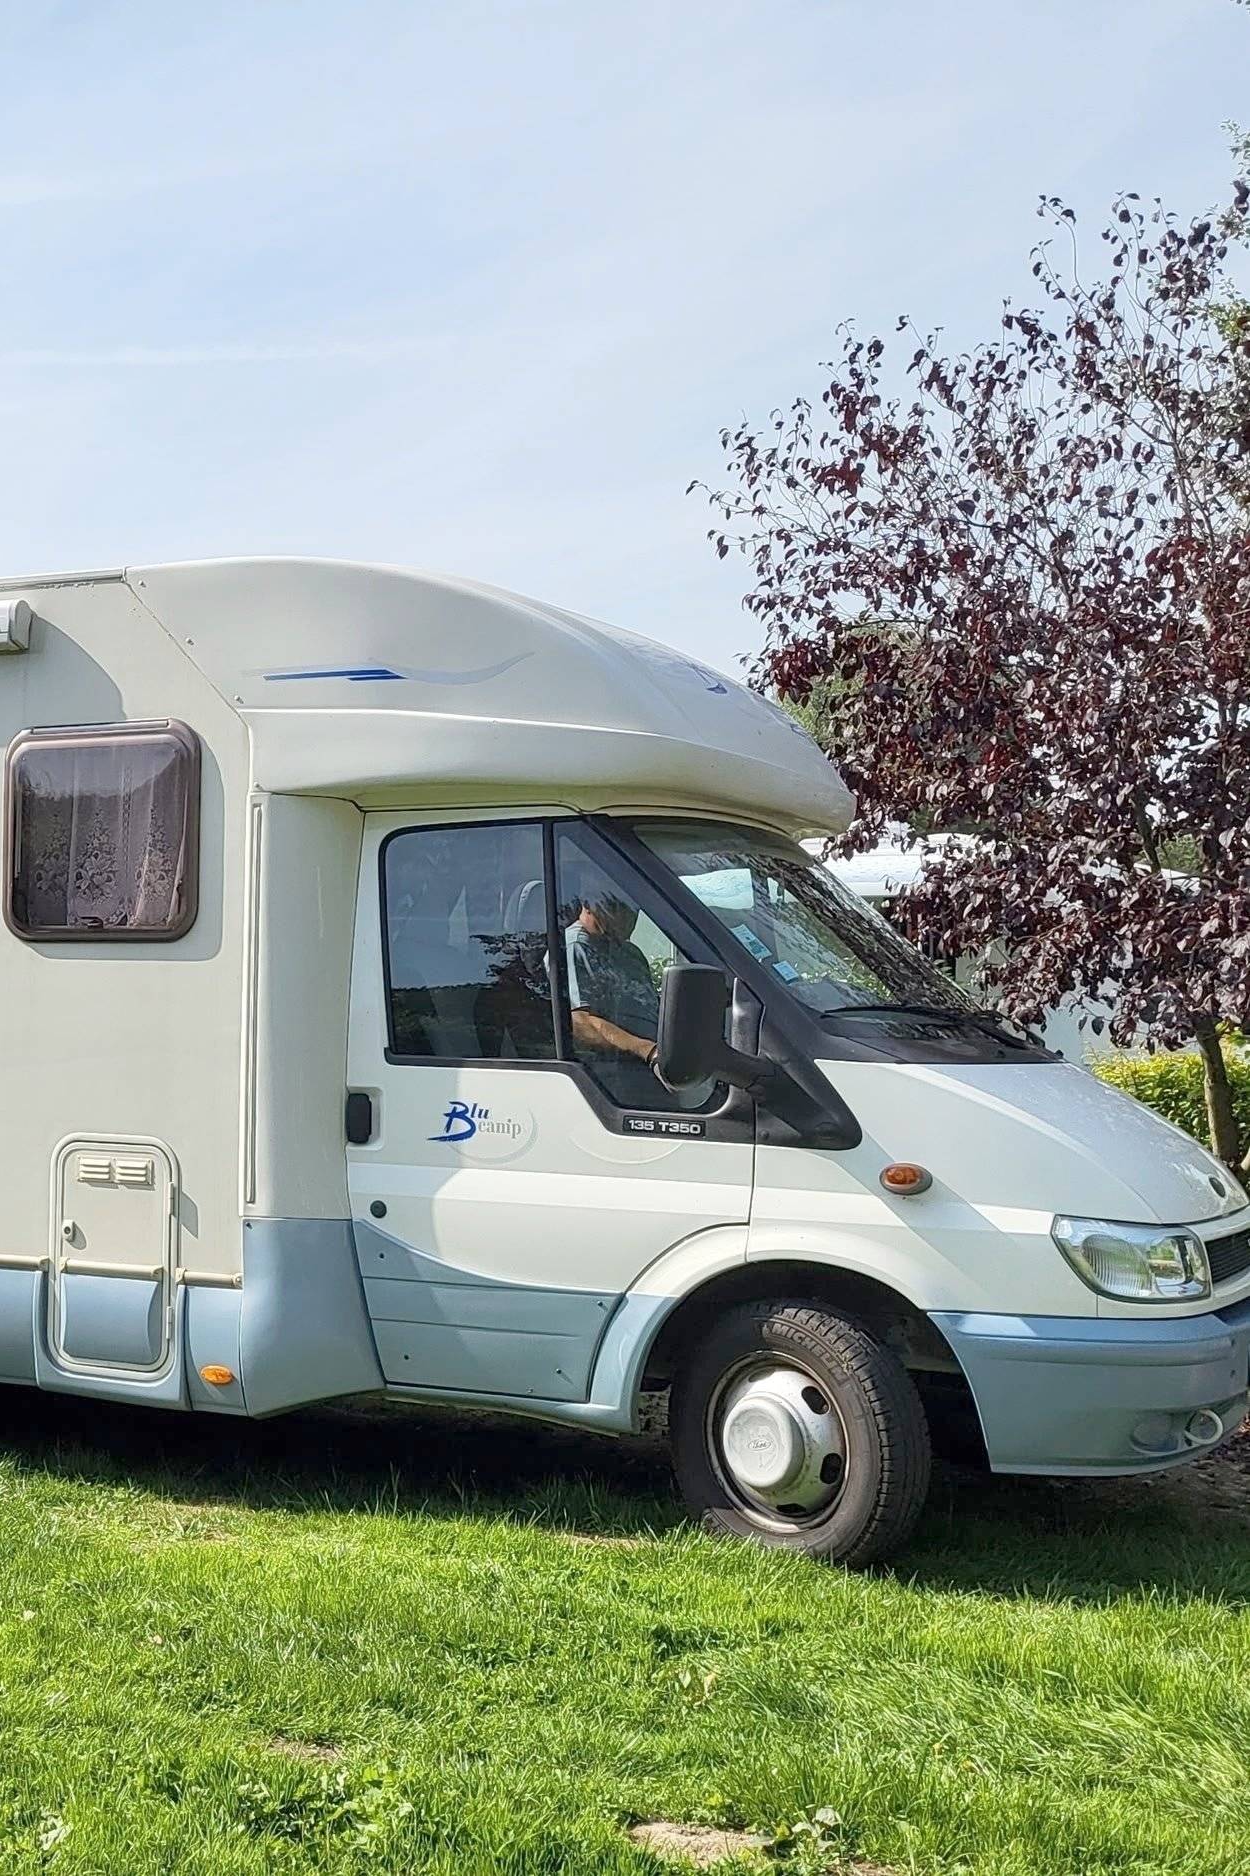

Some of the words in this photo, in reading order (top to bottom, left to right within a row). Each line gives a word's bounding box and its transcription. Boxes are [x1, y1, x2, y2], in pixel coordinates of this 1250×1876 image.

[427, 1101, 489, 1142] Blu
[628, 1119, 654, 1131] 135
[658, 1120, 701, 1134] T350
[771, 1322, 849, 1386] MICHELIN
